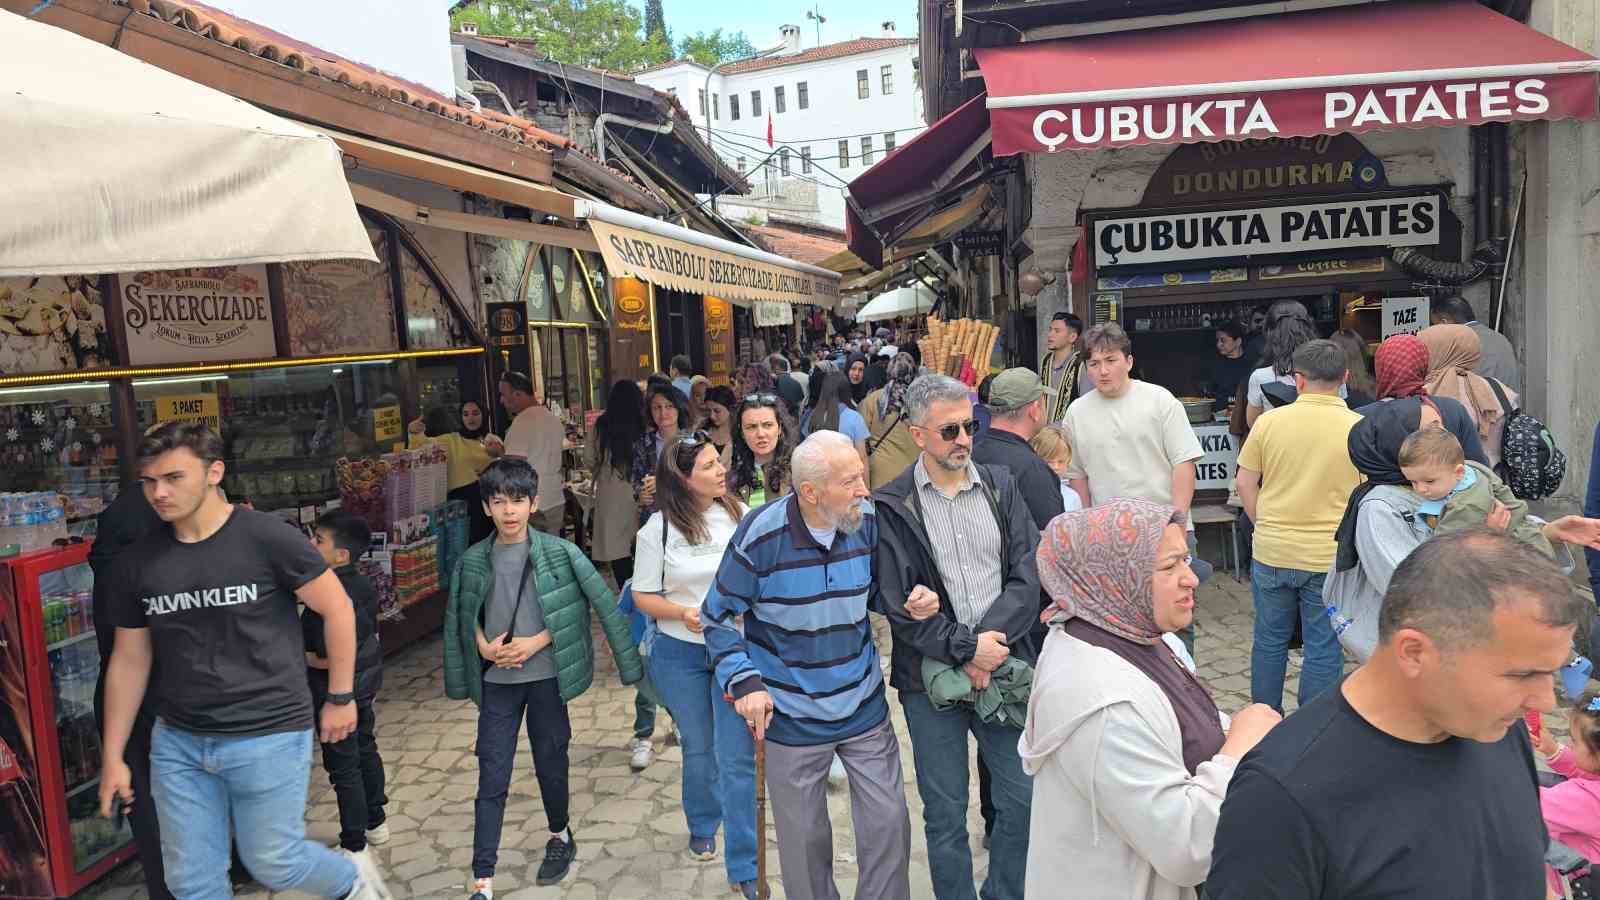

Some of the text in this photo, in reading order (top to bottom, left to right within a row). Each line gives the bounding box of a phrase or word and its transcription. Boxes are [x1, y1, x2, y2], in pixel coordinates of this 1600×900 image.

[1033, 79, 1549, 152] ÇUBUKTA PATATES
[1173, 160, 1354, 194] DONDURMA
[1100, 201, 1435, 264] ÇUBUKTA PATATES
[610, 233, 706, 280] SAFRANBOLU
[125, 284, 267, 335] ŞEKERCİZADE
[1393, 307, 1417, 326] TAZE
[172, 399, 204, 415] 3 PAKET
[1200, 434, 1232, 452] KTA
[202, 583, 258, 608] KLEIN
